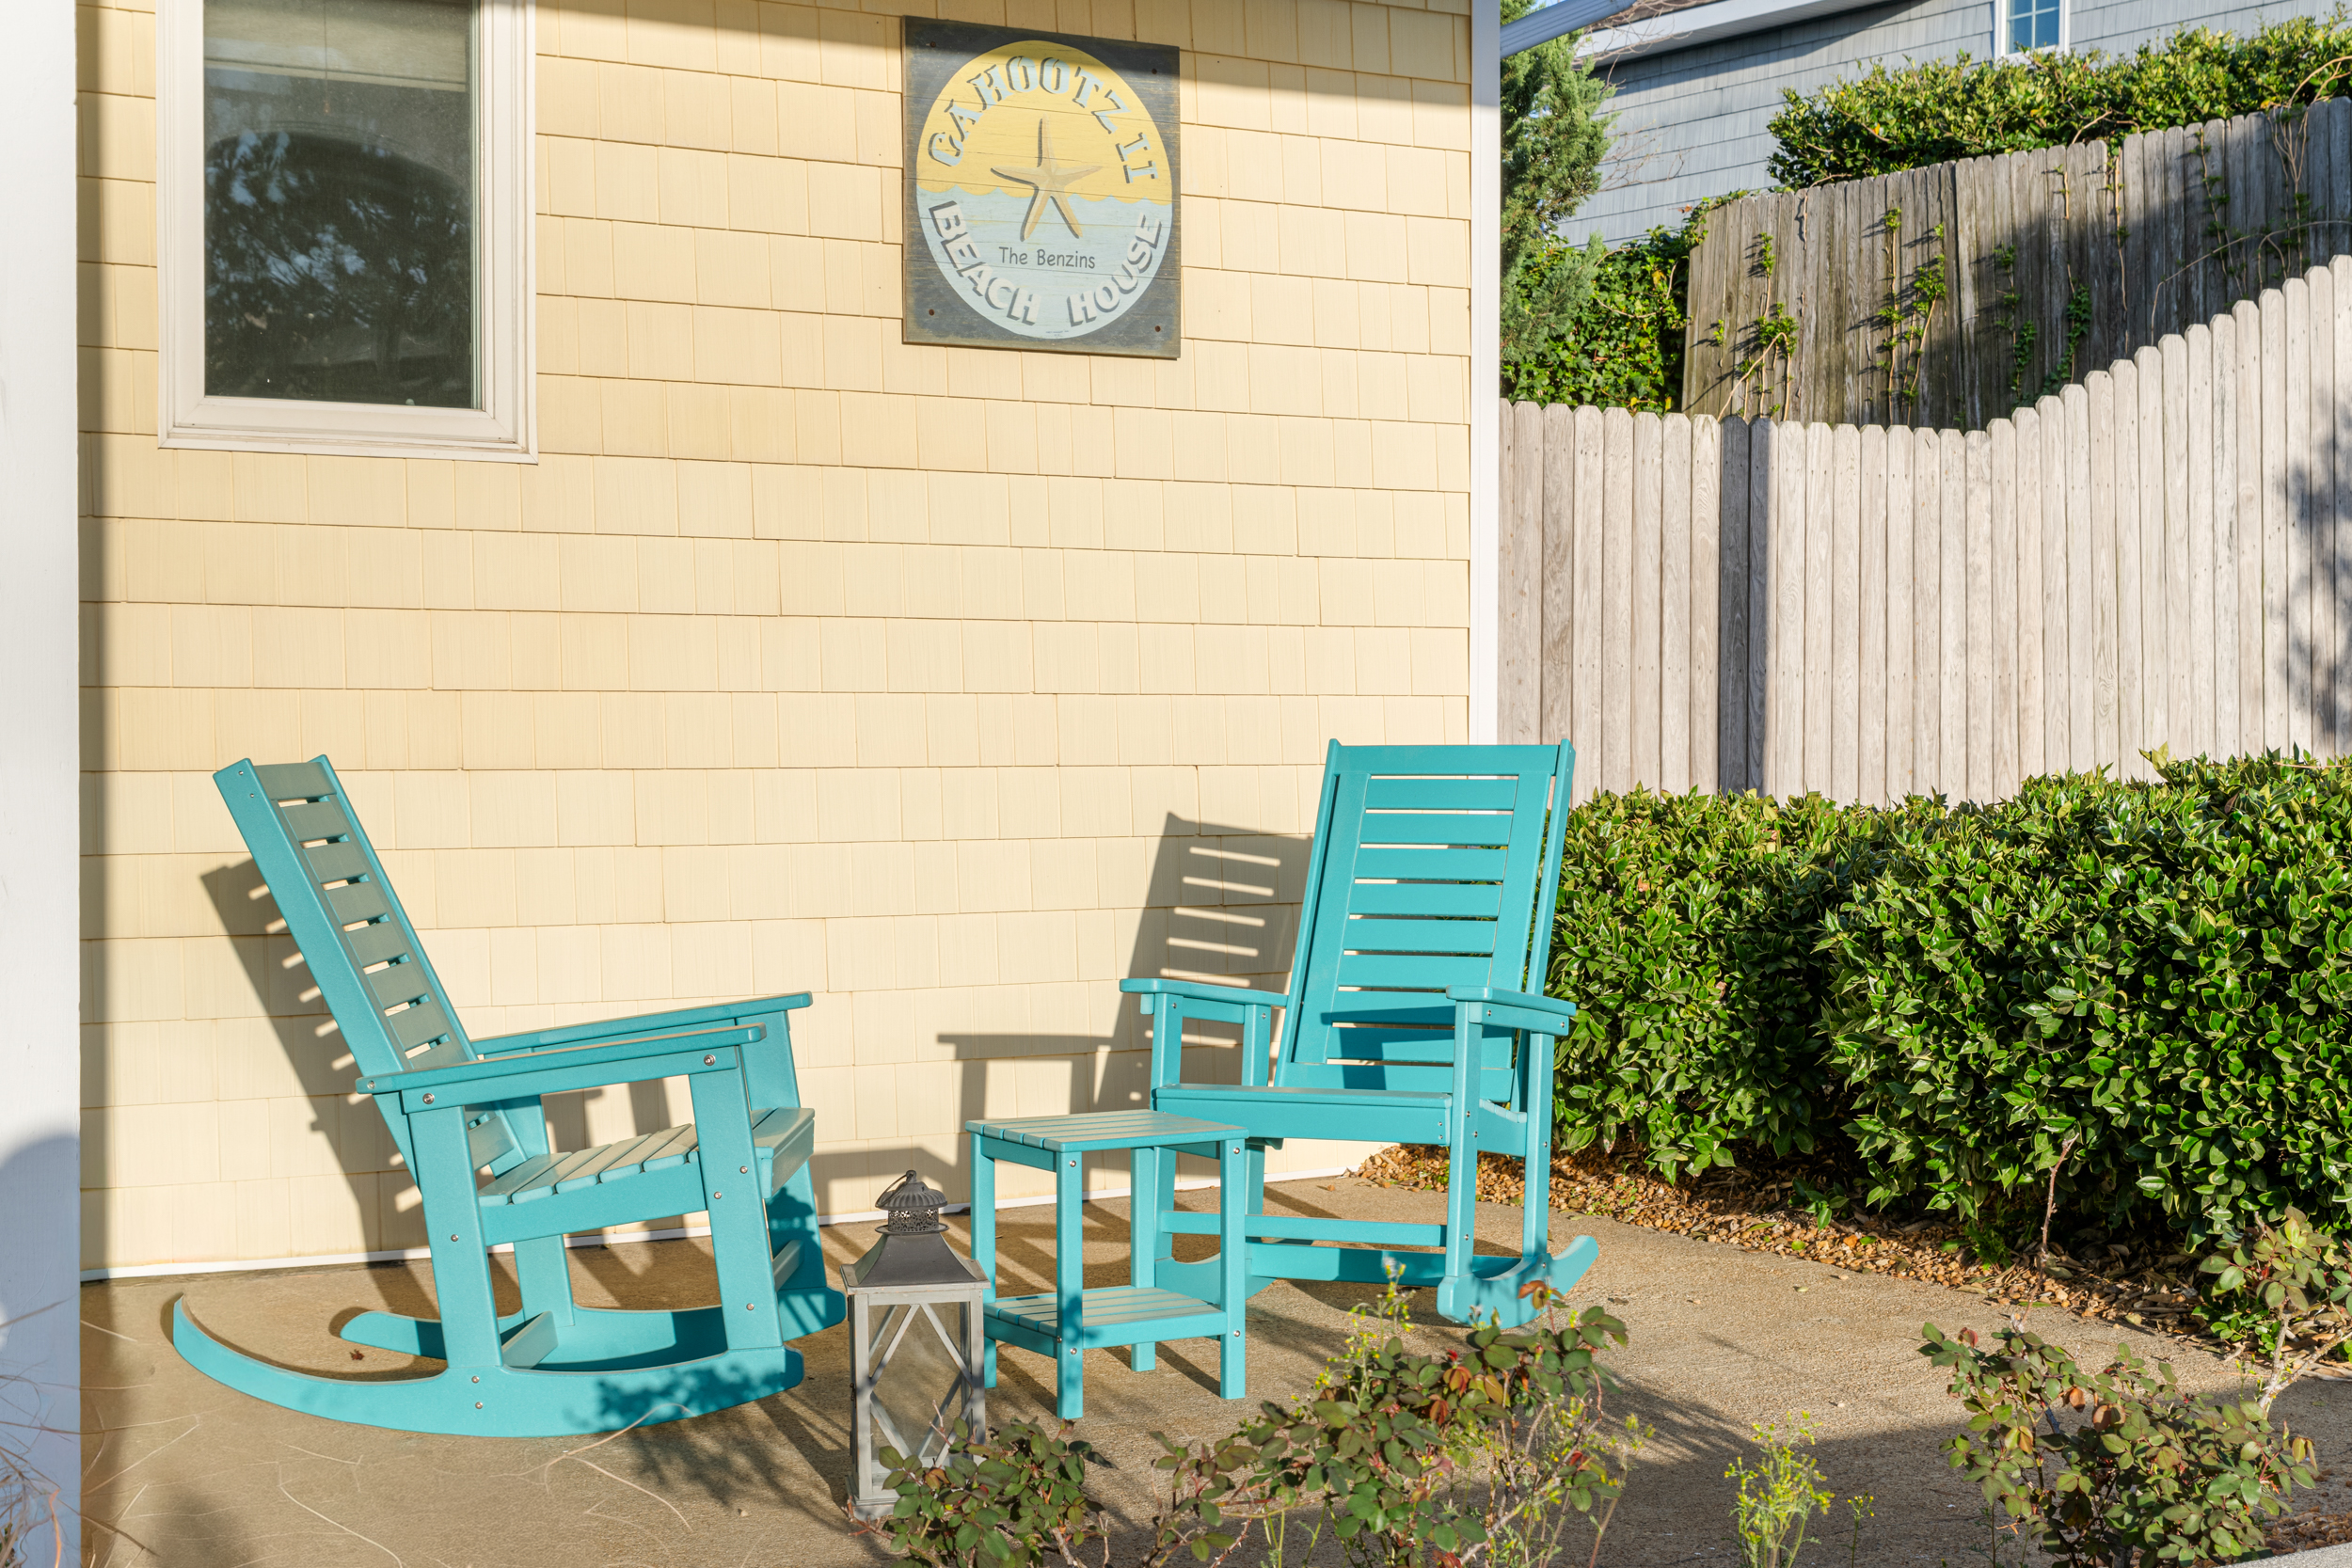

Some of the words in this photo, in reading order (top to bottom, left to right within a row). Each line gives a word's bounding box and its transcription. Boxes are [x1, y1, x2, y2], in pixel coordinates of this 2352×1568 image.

[929, 55, 1132, 167] CAHOOTZ
[1115, 132, 1158, 184] II
[928, 200, 1041, 326] BEACH
[1066, 212, 1161, 327] HOUSE
[998, 246, 1028, 265] The
[1037, 248, 1096, 269] Benzins
